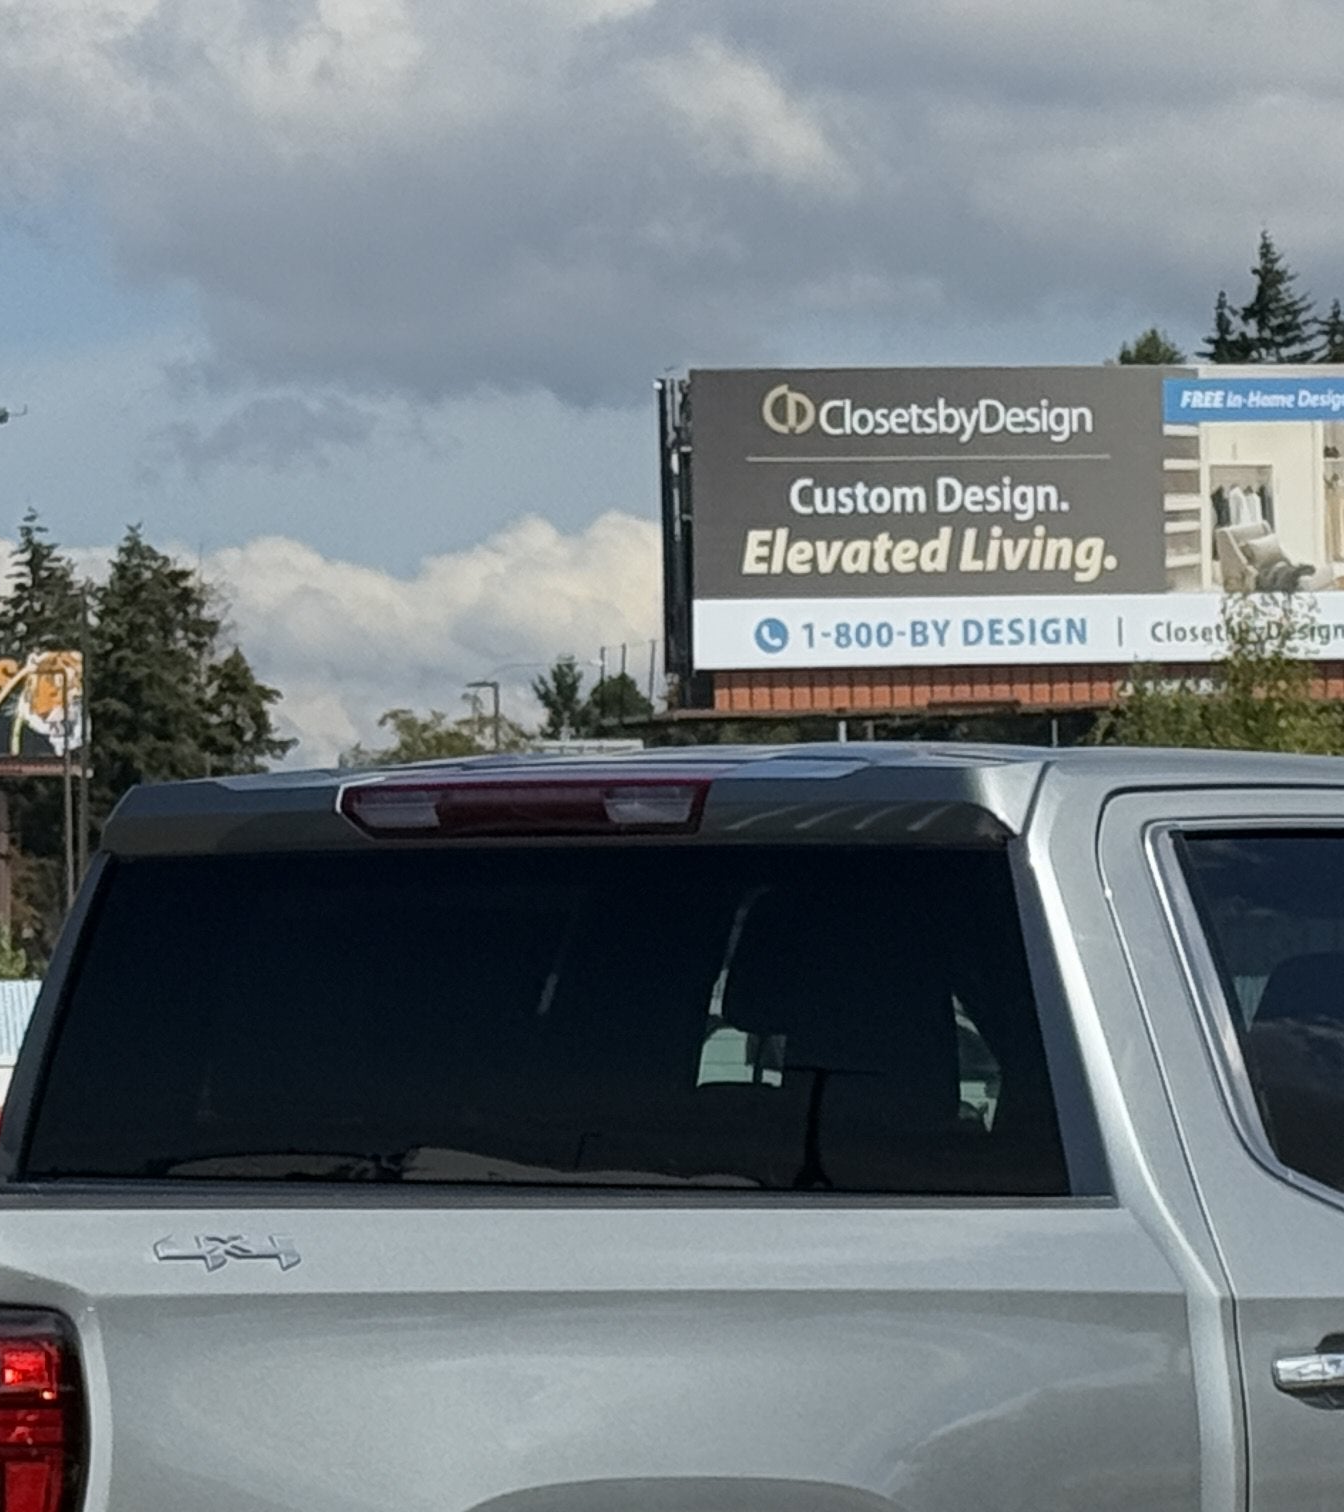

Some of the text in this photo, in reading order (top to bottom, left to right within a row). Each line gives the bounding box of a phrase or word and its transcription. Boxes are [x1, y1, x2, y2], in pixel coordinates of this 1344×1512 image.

[819, 398, 1093, 442] ClosetsbyDesign
[1180, 390, 1224, 408] FREE
[1226, 390, 1295, 408] In-Home
[790, 476, 1070, 521] Custom Design.
[742, 524, 1118, 582] Elevated Living.
[802, 617, 1088, 648] 1-800-BY DESIGN
